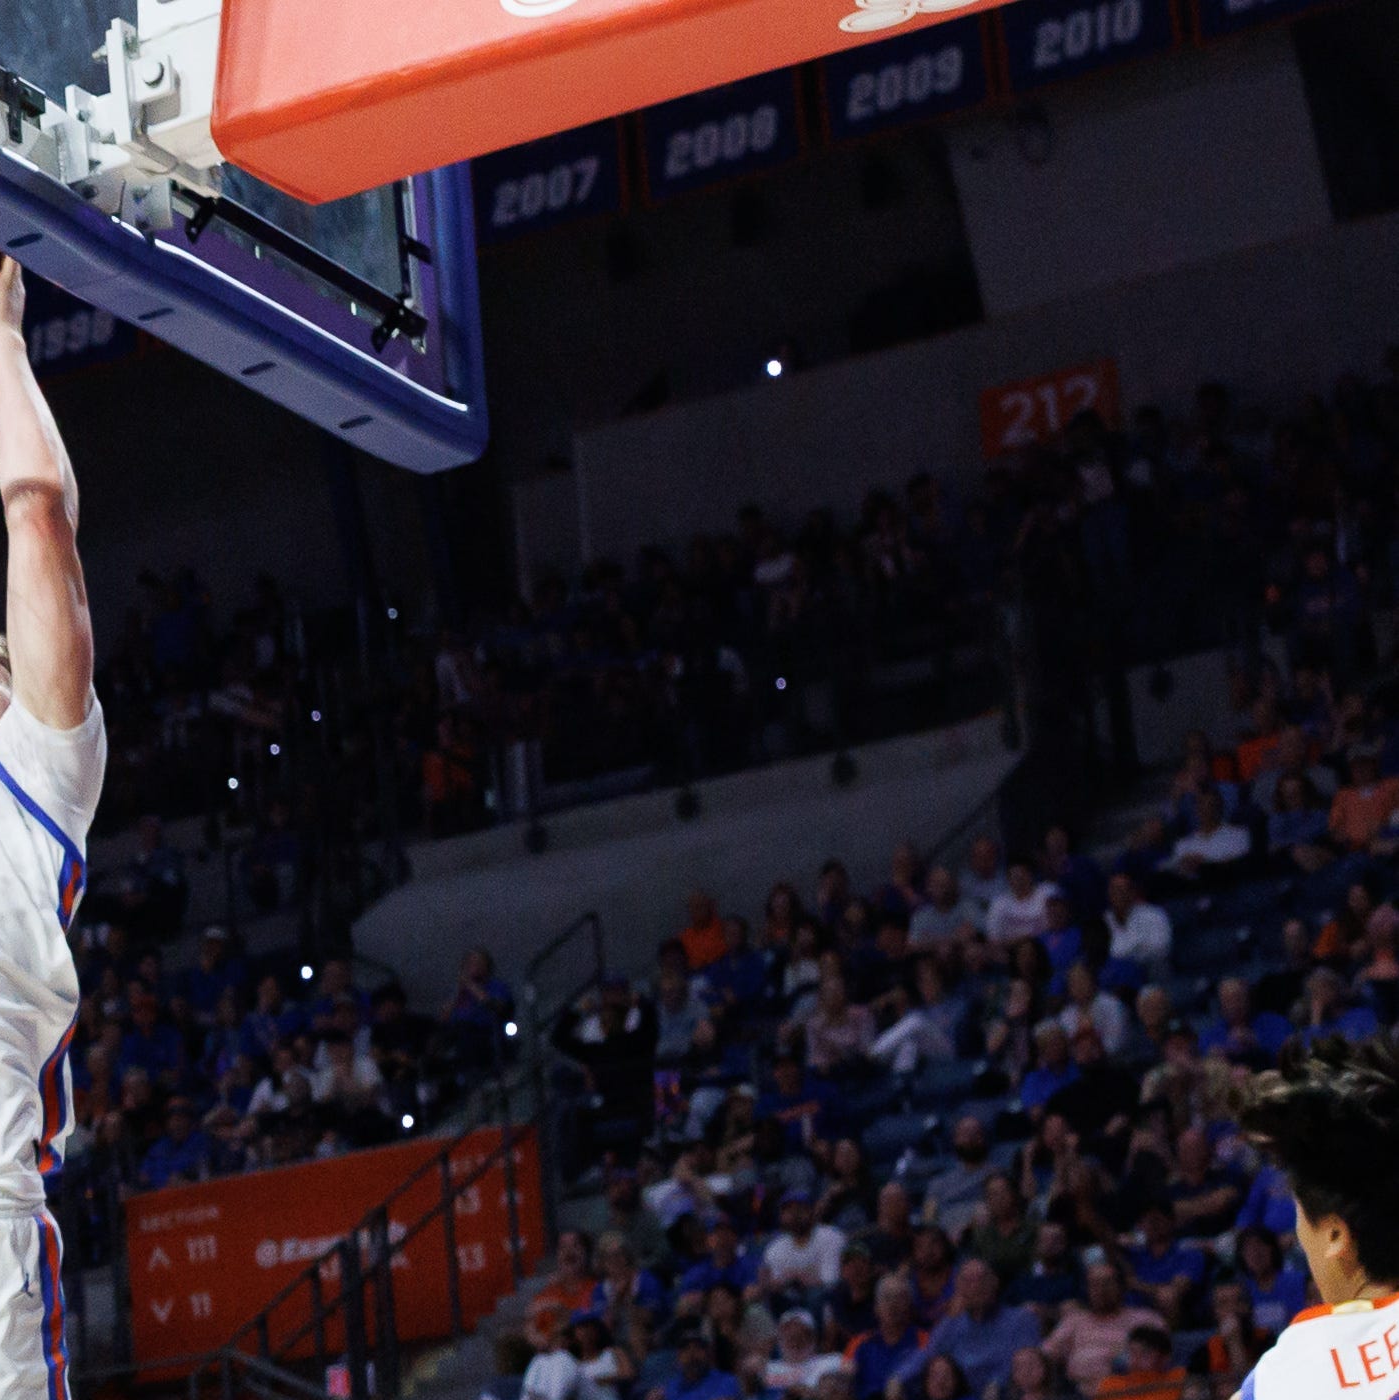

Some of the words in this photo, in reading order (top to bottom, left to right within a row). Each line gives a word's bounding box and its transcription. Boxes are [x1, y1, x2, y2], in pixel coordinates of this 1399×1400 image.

[1034, 0, 1141, 69] 2010
[845, 46, 963, 122] 2009
[492, 155, 600, 228] 2007
